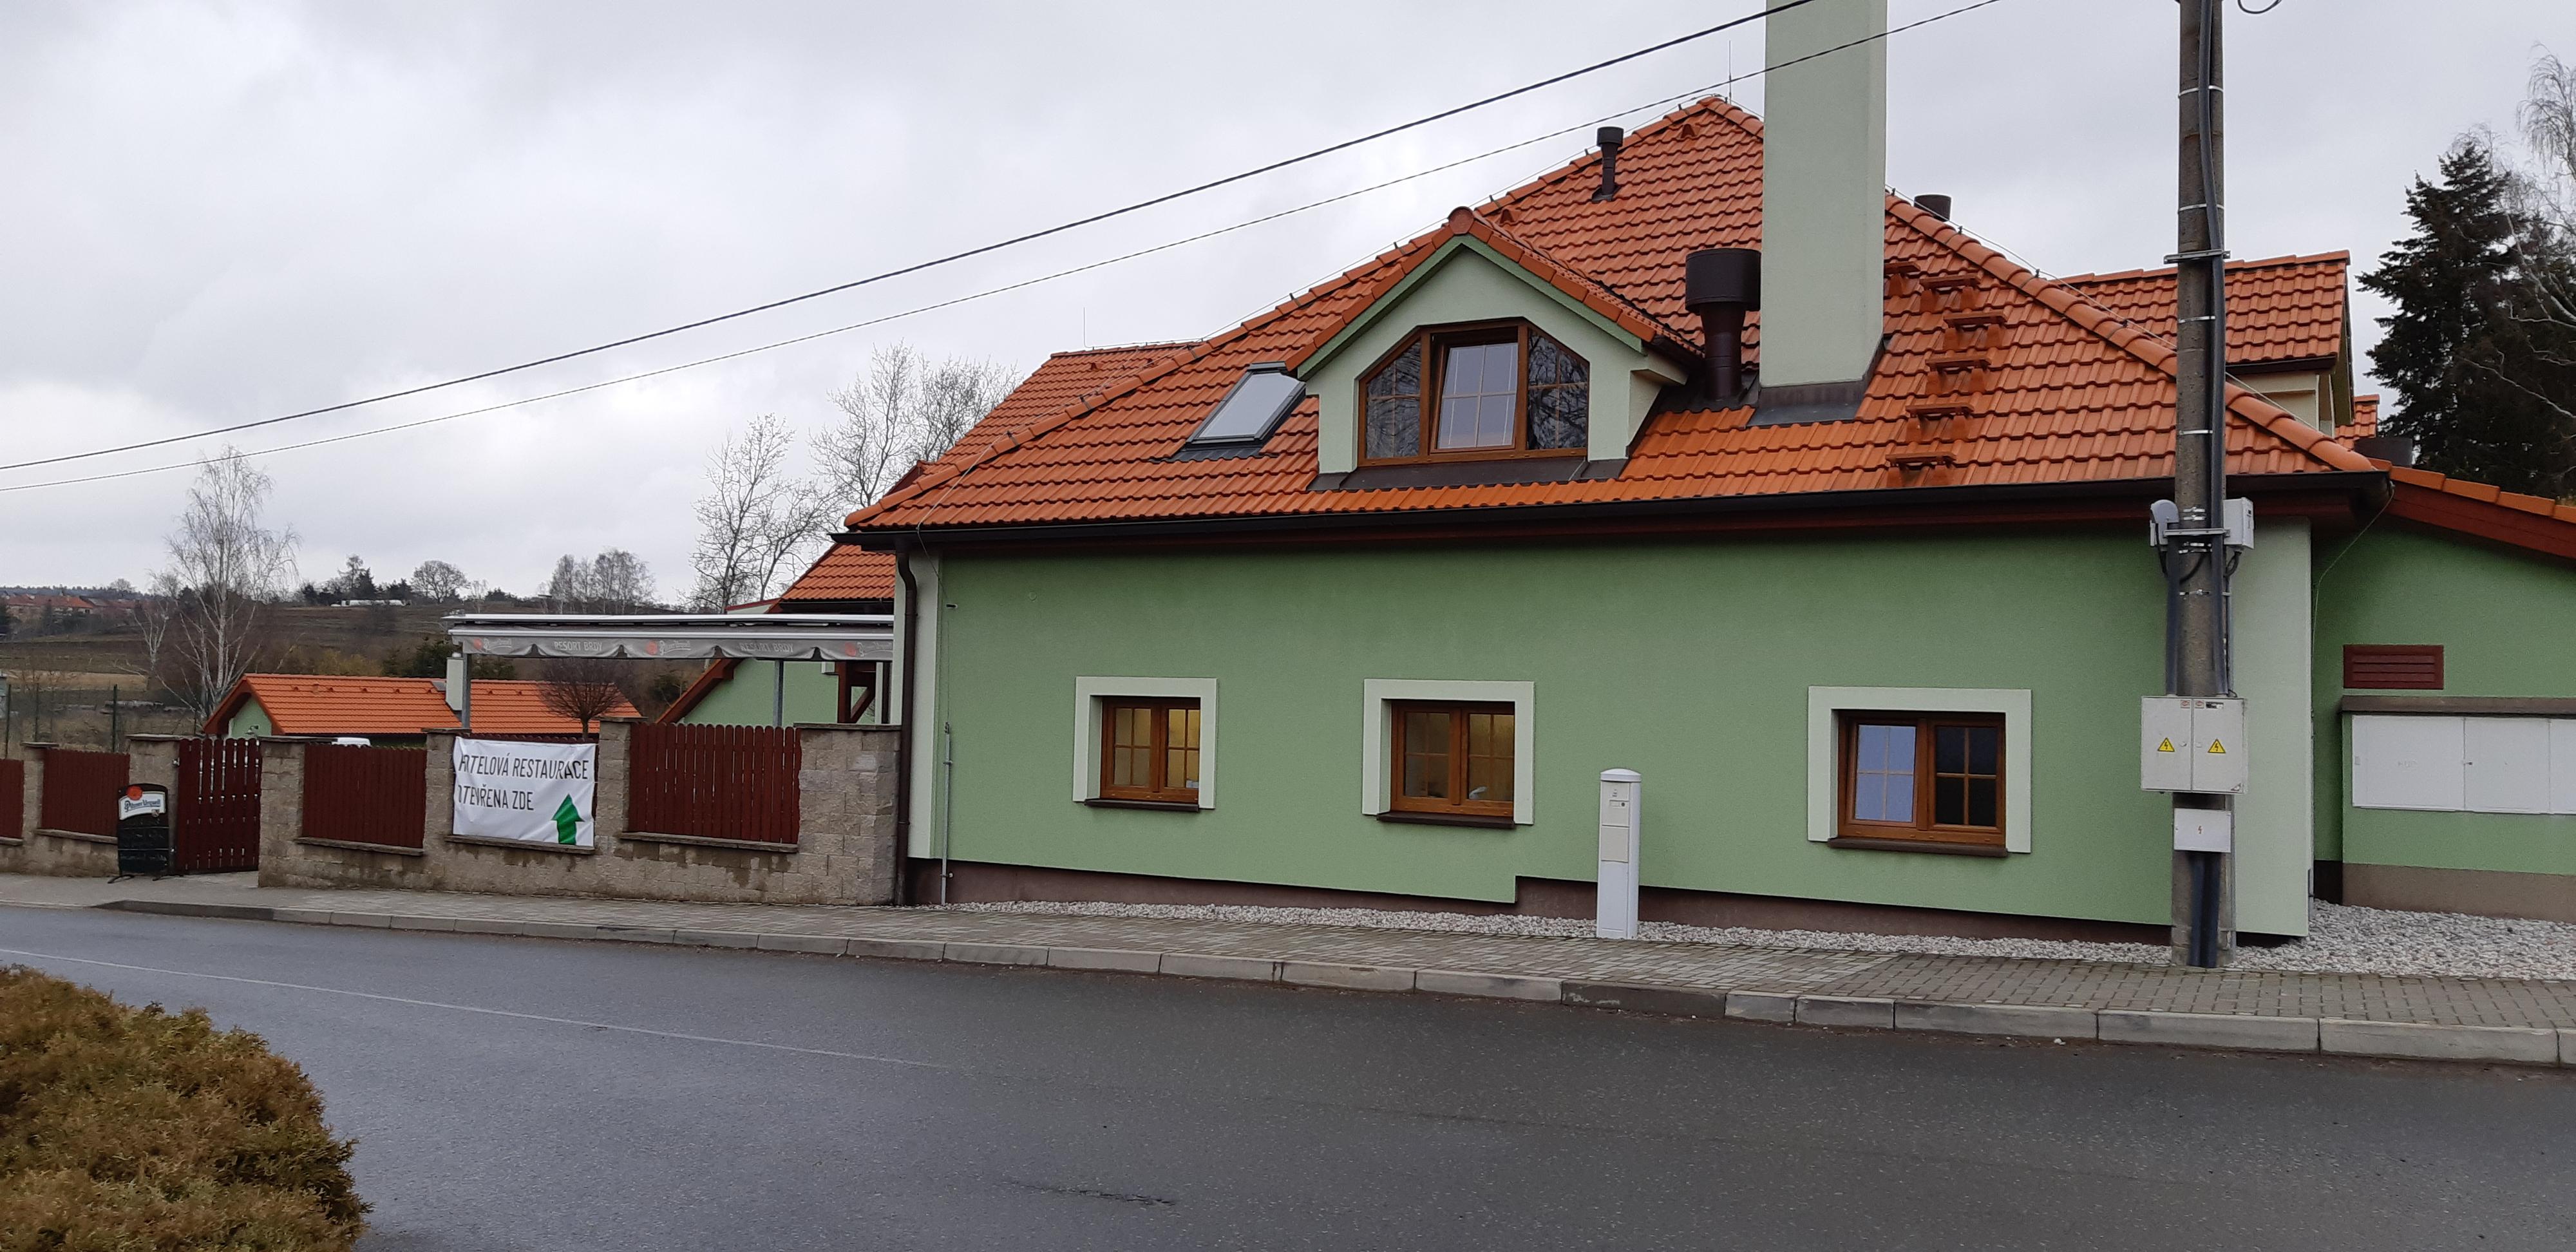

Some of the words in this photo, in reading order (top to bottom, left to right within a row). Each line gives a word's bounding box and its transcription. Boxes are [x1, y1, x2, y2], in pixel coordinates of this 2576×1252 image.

[554, 641, 580, 650] RESORT
[773, 643, 793, 653] BRDY
[512, 758, 589, 779] RESTAURACE
[512, 791, 534, 810] ZDE
